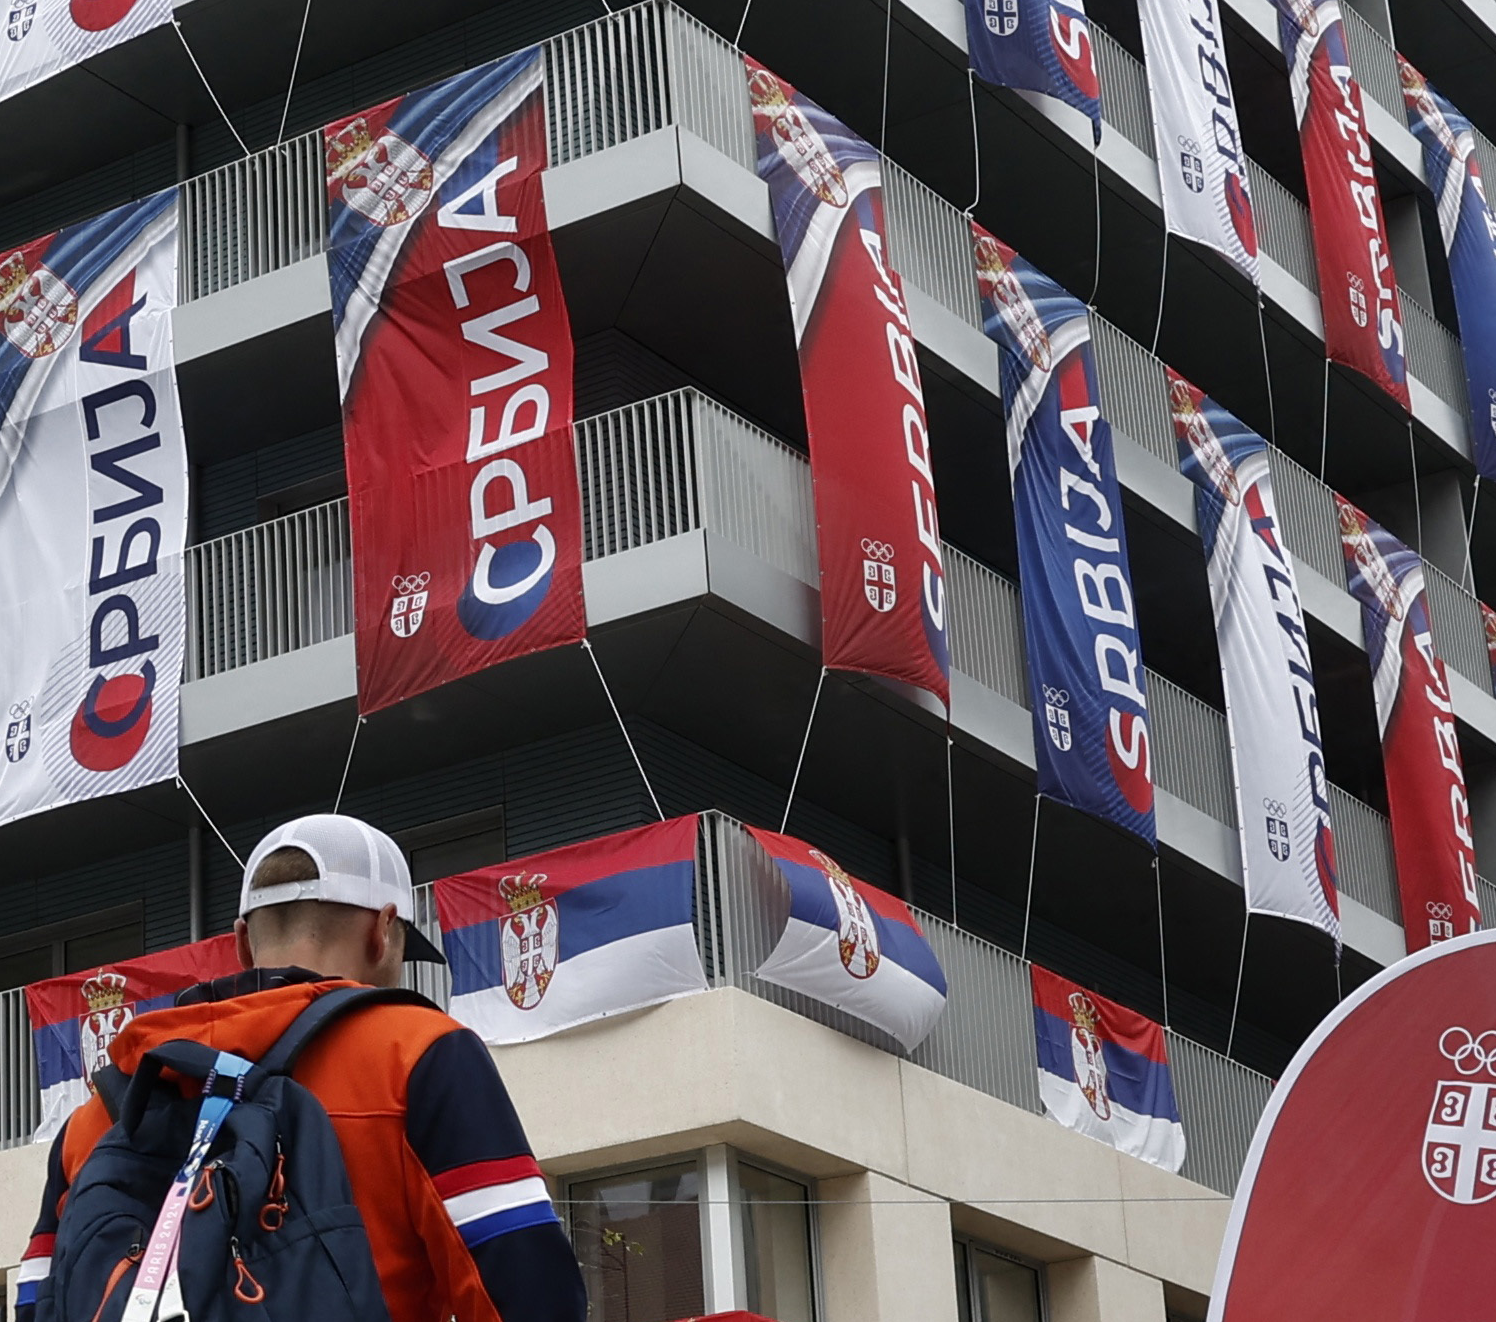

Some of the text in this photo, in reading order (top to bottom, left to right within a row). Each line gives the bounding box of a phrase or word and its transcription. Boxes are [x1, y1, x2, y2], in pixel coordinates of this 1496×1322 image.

[438, 155, 556, 605] СРБИЈА
[1331, 65, 1404, 353] SRBIJA
[79, 291, 161, 739] СРБИЈА
[859, 228, 946, 635] SERBIA
[1059, 404, 1152, 772] SRBIJA
[143, 1200, 183, 1285] PARIS 2024
